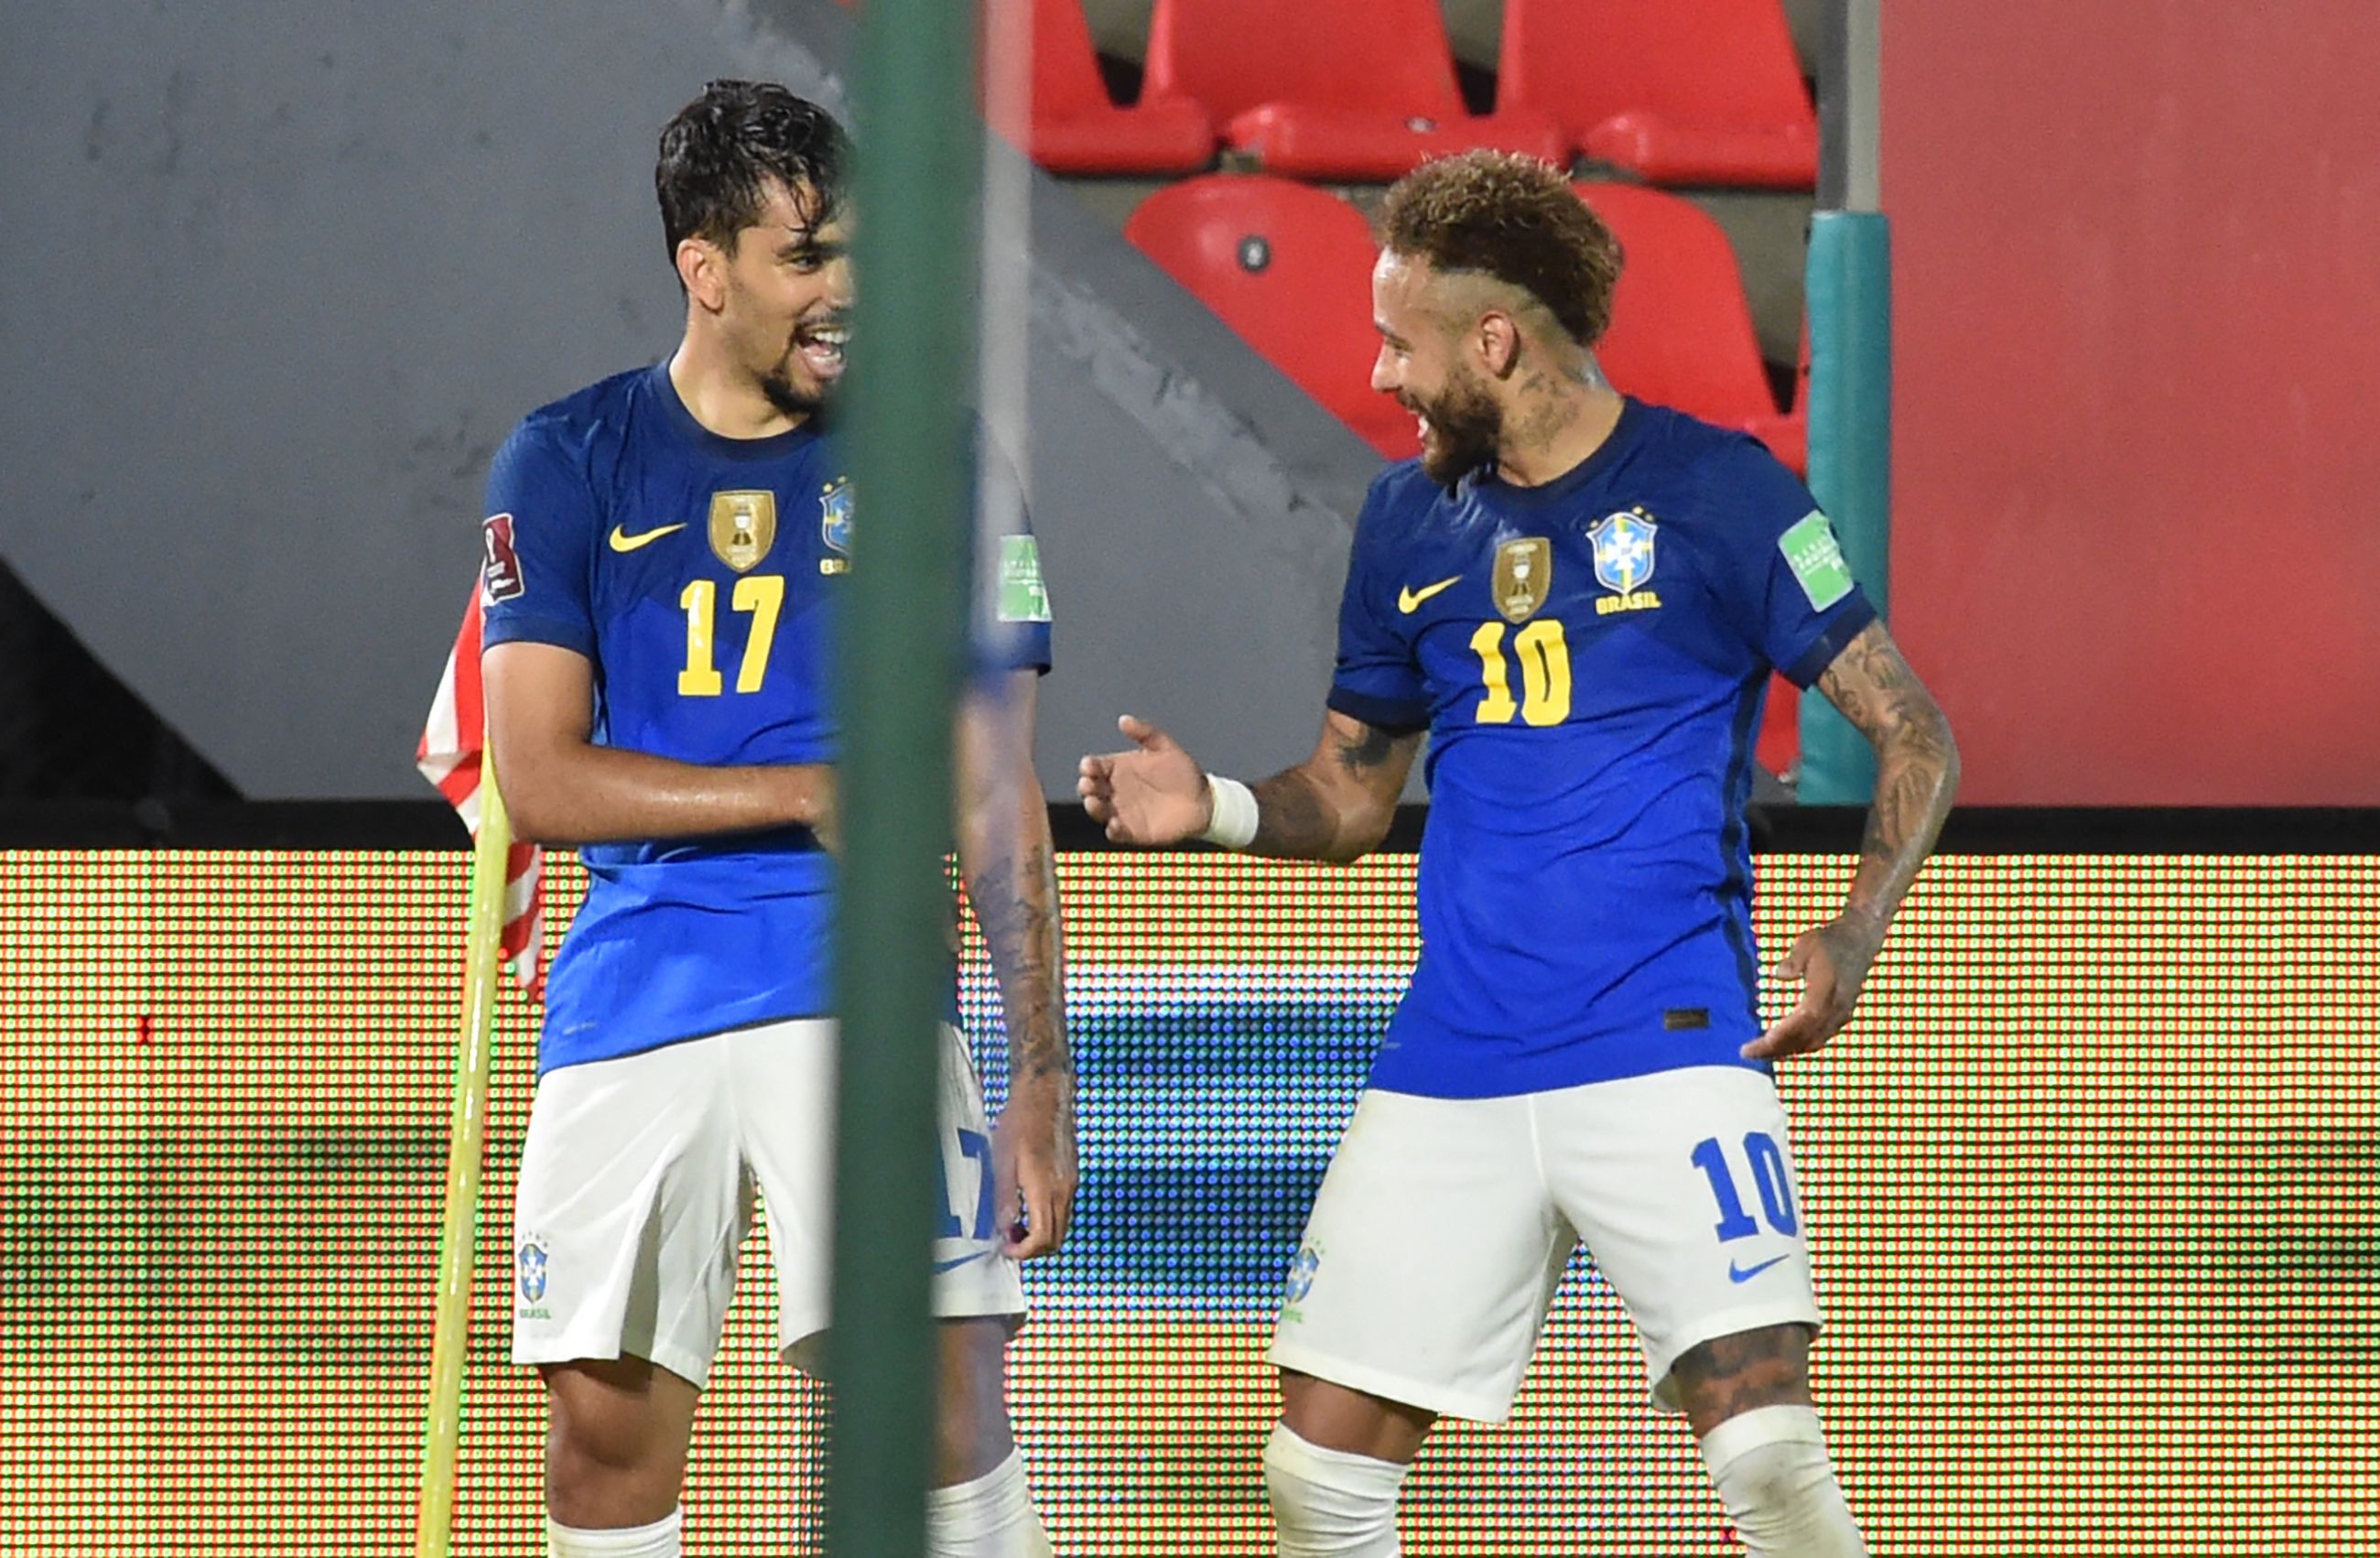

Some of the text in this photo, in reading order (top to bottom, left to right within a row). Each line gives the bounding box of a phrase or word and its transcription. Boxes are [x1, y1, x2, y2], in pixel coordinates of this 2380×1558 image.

[678, 576, 784, 696] 17
[1596, 591, 1662, 614] BRASIL
[1469, 620, 1571, 726] 10
[1691, 1131, 1797, 1243] 10
